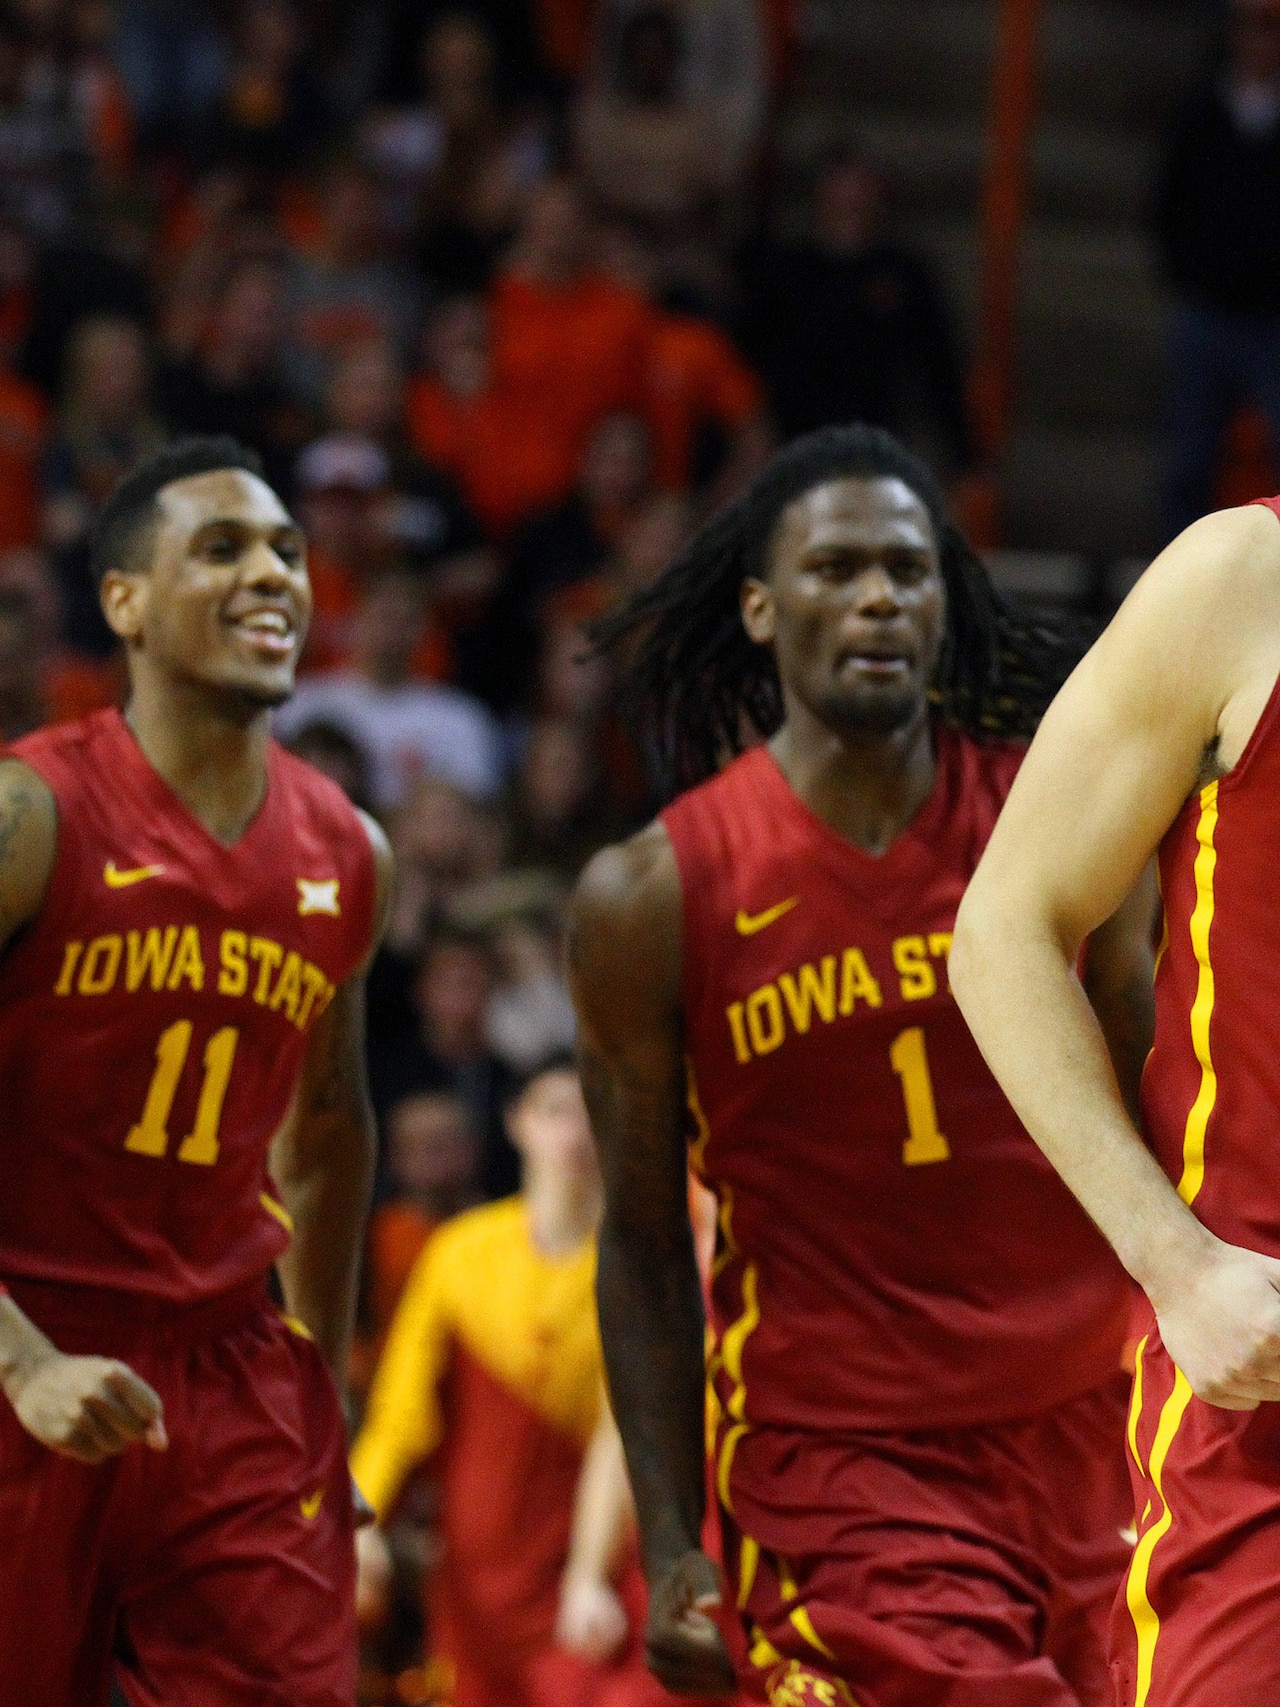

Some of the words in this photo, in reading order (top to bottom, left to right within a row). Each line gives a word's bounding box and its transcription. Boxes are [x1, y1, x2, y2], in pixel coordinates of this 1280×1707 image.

[54, 925, 206, 996] IOWA
[726, 946, 882, 1065] IOWA
[124, 1019, 239, 1166] 11
[889, 1026, 951, 1166] 1
